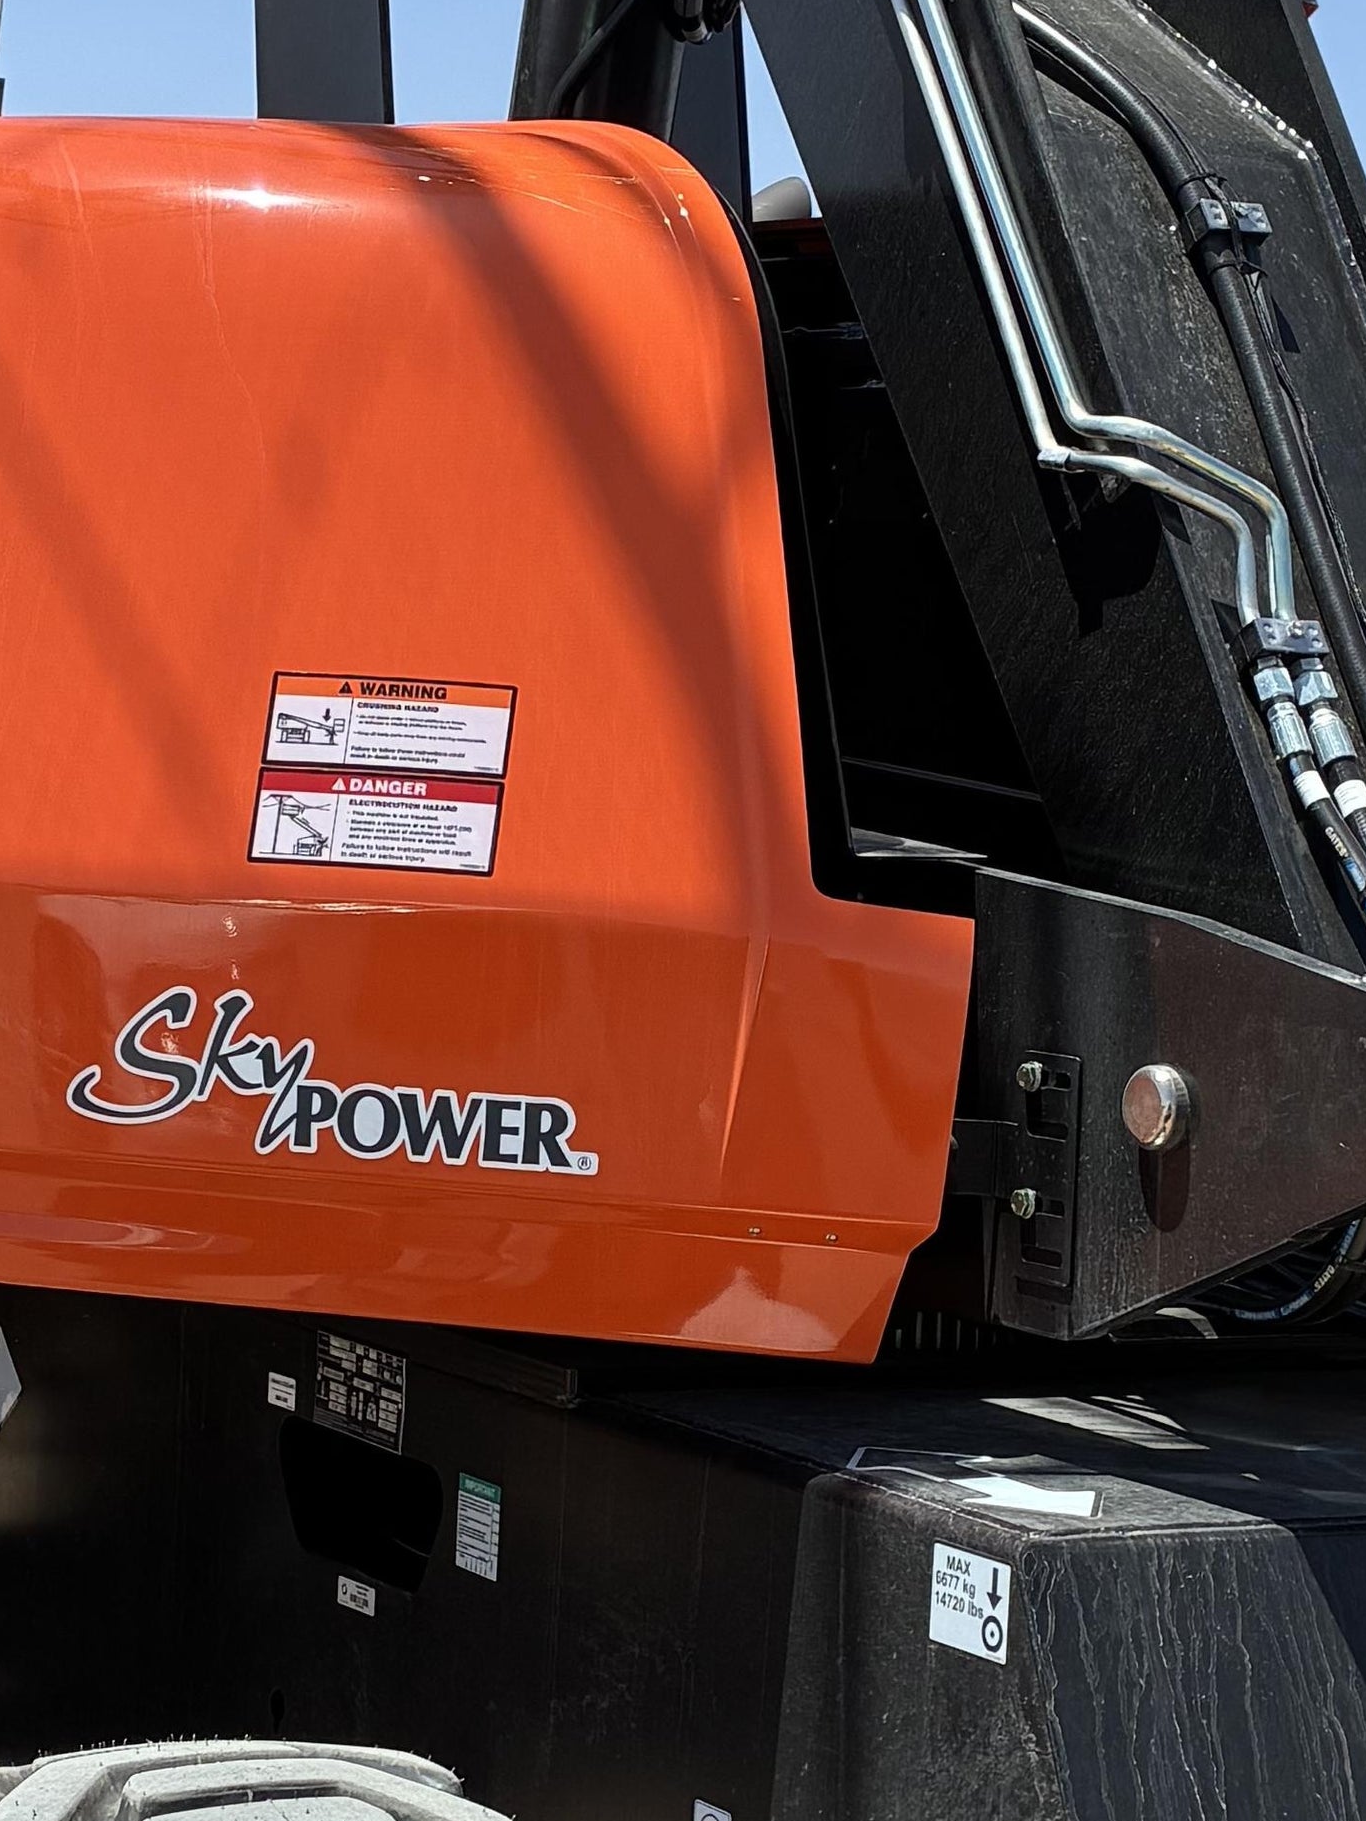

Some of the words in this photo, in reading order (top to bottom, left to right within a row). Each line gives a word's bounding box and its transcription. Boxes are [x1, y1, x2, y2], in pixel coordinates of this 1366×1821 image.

[360, 682, 447, 700] WARNING
[404, 704, 439, 713] HAZARD
[349, 778, 427, 797] DANGER
[349, 798, 421, 810] ELECTROCUTION
[422, 803, 458, 813] HAZARD
[1325, 826, 1349, 858] GATES
[68, 988, 312, 1152] Sky
[290, 1082, 575, 1170] POWER
[946, 1555, 971, 1577] MAX
[935, 1570, 960, 1591] 6677
[963, 1578, 976, 1600] kg
[935, 1590, 966, 1614] 14720
[967, 1599, 984, 1620] lbs
